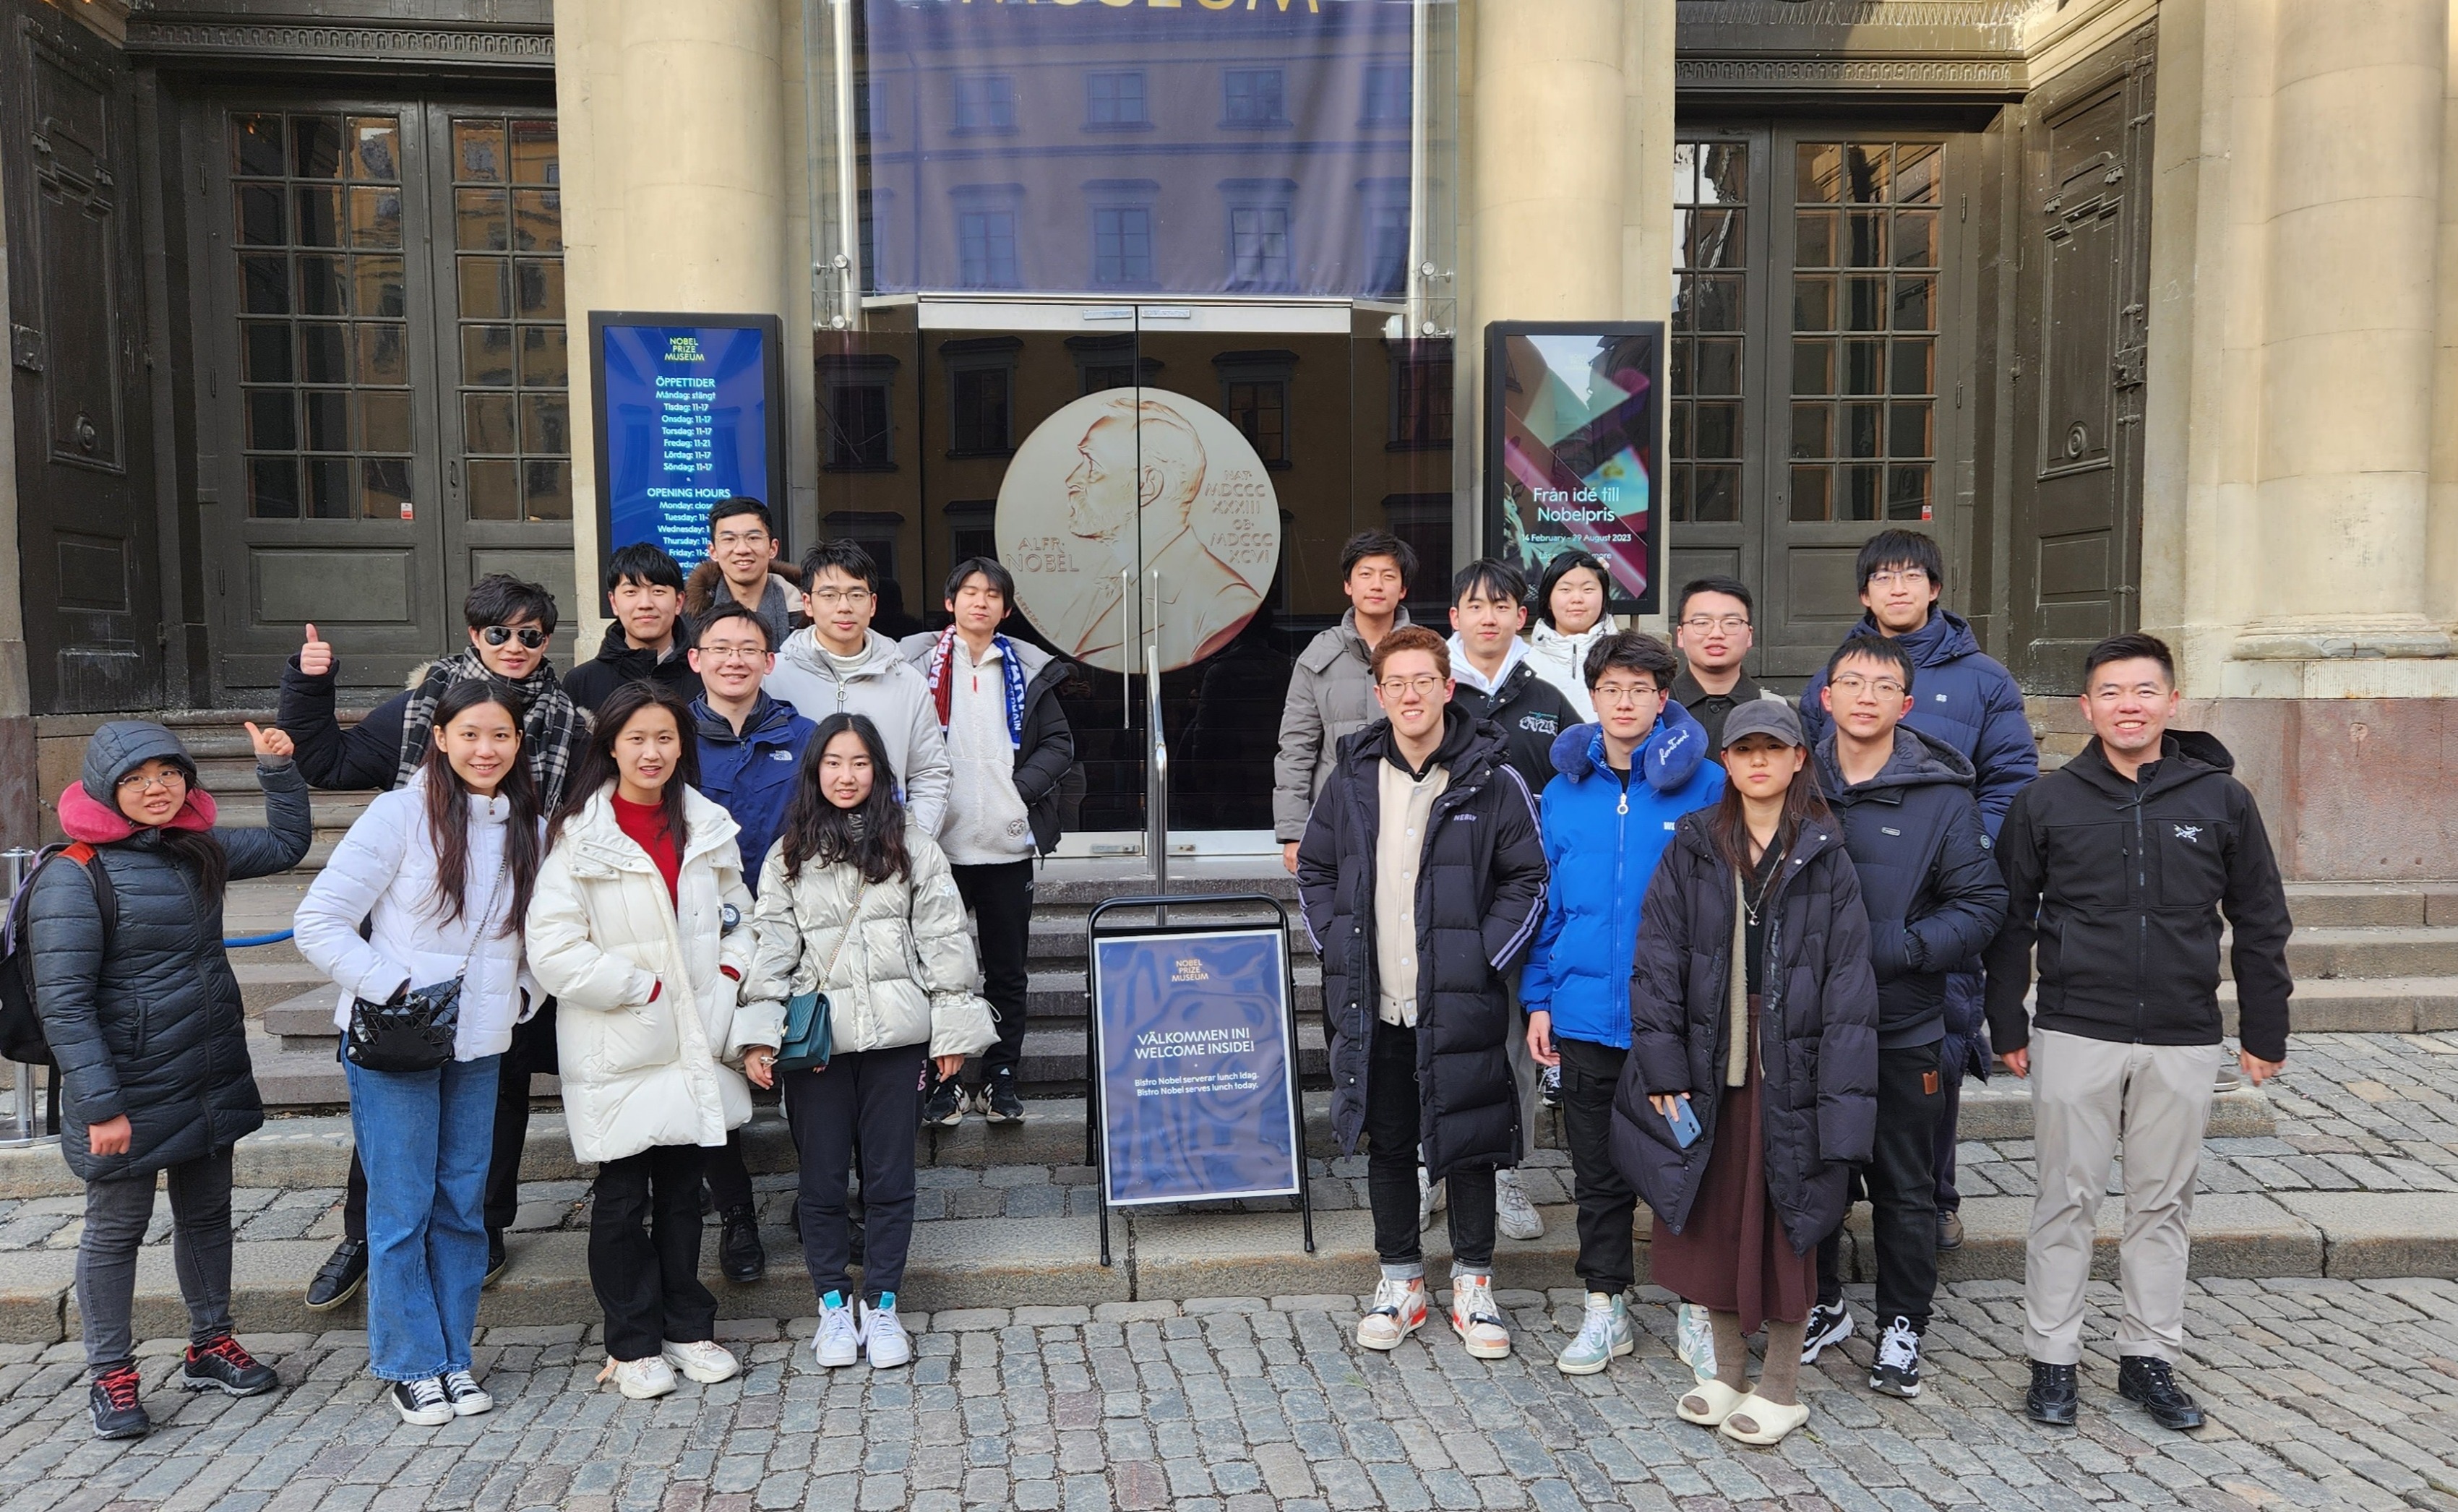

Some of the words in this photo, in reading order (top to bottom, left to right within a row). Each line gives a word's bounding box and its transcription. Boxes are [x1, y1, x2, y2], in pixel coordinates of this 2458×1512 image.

[656, 376, 716, 387] ÖPPETTIDER
[656, 391, 690, 400] Måndag:
[692, 392, 716, 401] stängt
[663, 403, 691, 413] Tisdag:
[661, 415, 694, 424] Onsdag:
[661, 427, 695, 437] Torsdag:
[663, 439, 692, 448] Fredag:
[664, 451, 694, 460] Lördag:
[663, 463, 695, 472] Söndag:
[647, 488, 692, 497] OPENING
[695, 489, 731, 498] HOURS
[1205, 483, 1265, 497] MDCCC
[1533, 486, 1568, 502] Från
[1573, 486, 1597, 502] idé
[1602, 487, 1620, 502] till
[659, 502, 694, 510] Monday:
[1212, 500, 1260, 514] XXXIII
[664, 513, 697, 522] Tuesday:
[1537, 507, 1615, 525] Nobelpris
[657, 525, 705, 534] Wednesday:
[663, 537, 700, 546] Thursday:
[1210, 533, 1273, 546] MDCCC
[1531, 534, 1566, 543] February
[669, 549, 695, 558] Friday:
[1229, 549, 1269, 563] XCVI
[1006, 554, 1079, 572] NOBEL
[1176, 958, 1203, 967] NOBEL
[1172, 973, 1209, 981] MUSEUM
[1137, 1028, 1229, 1045] VÄLKOMMEN
[1232, 1027, 1250, 1039] IN!
[1134, 1044, 1205, 1060] WELCOME
[1208, 1040, 1255, 1054] INSIDE!
[1158, 1076, 1182, 1085] Nobel
[1161, 1086, 1184, 1095] Nobel
[1234, 1081, 1259, 1090] today.
